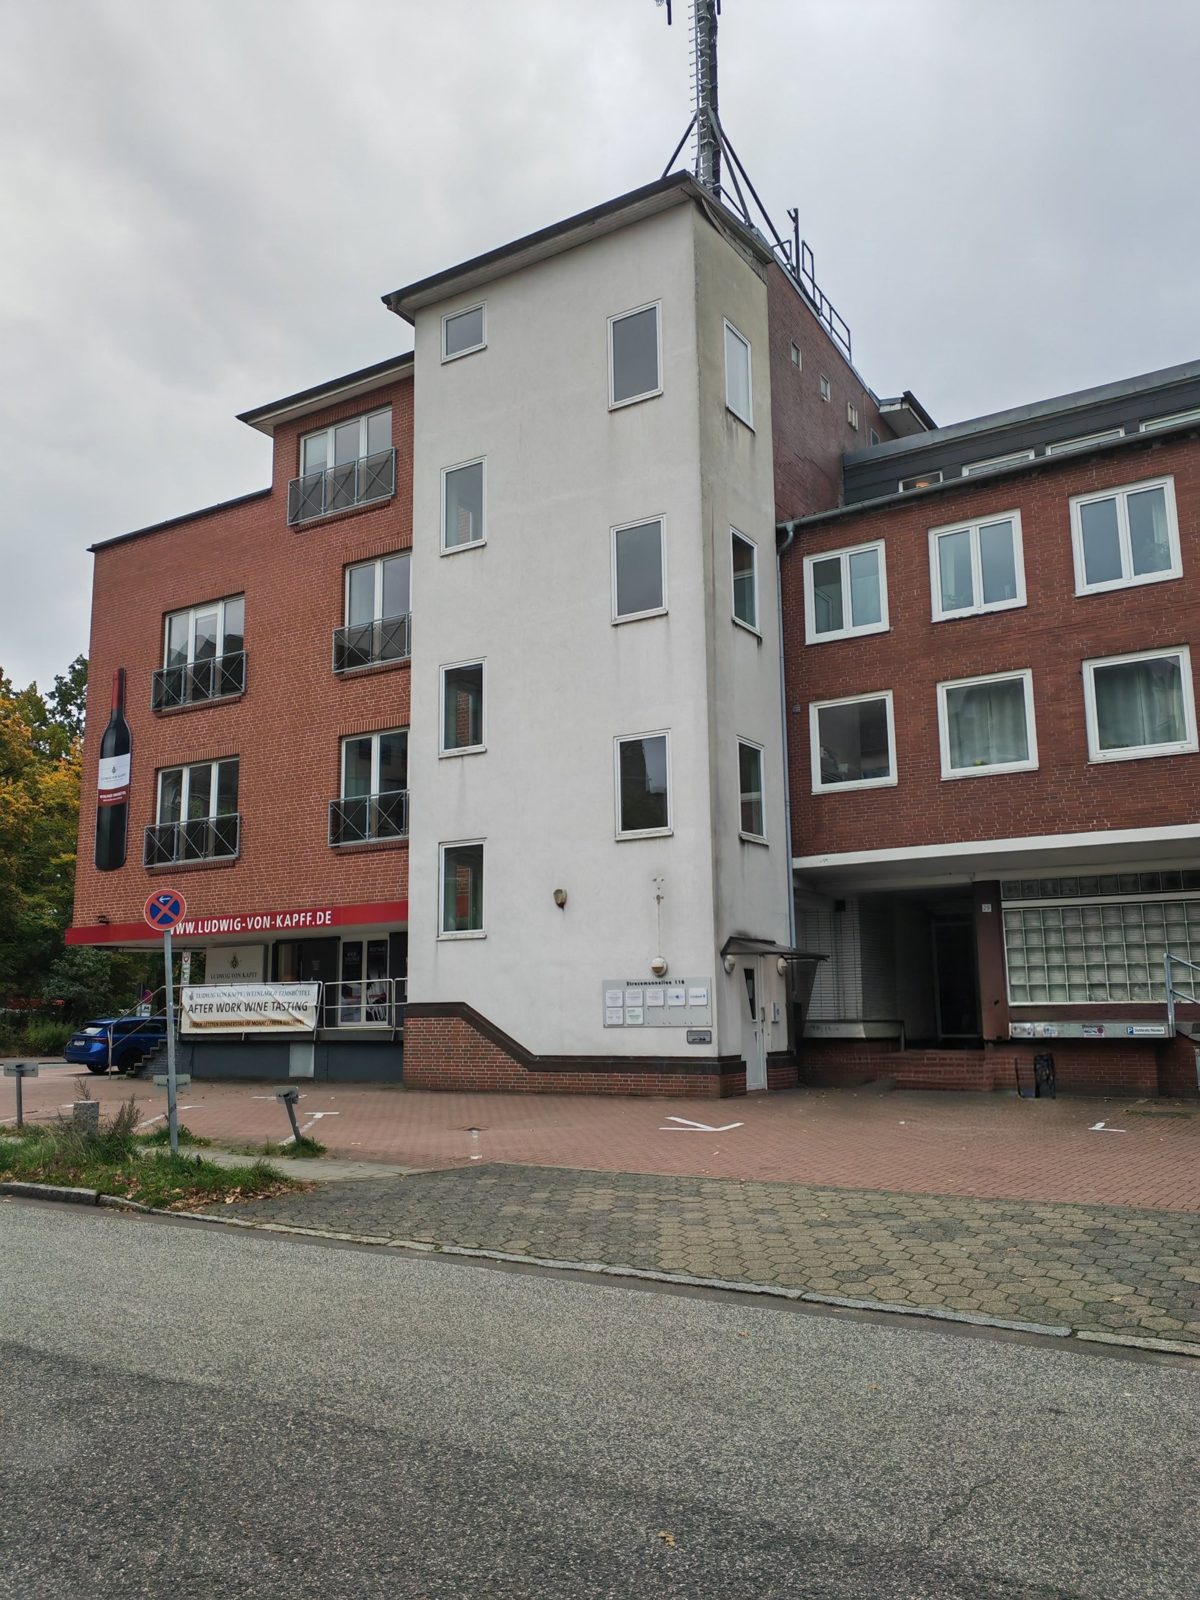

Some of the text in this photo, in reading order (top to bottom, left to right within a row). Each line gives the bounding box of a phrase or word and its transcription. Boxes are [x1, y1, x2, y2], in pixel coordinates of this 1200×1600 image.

[187, 1001, 308, 1014] AFTER WORK WINE TASTING
